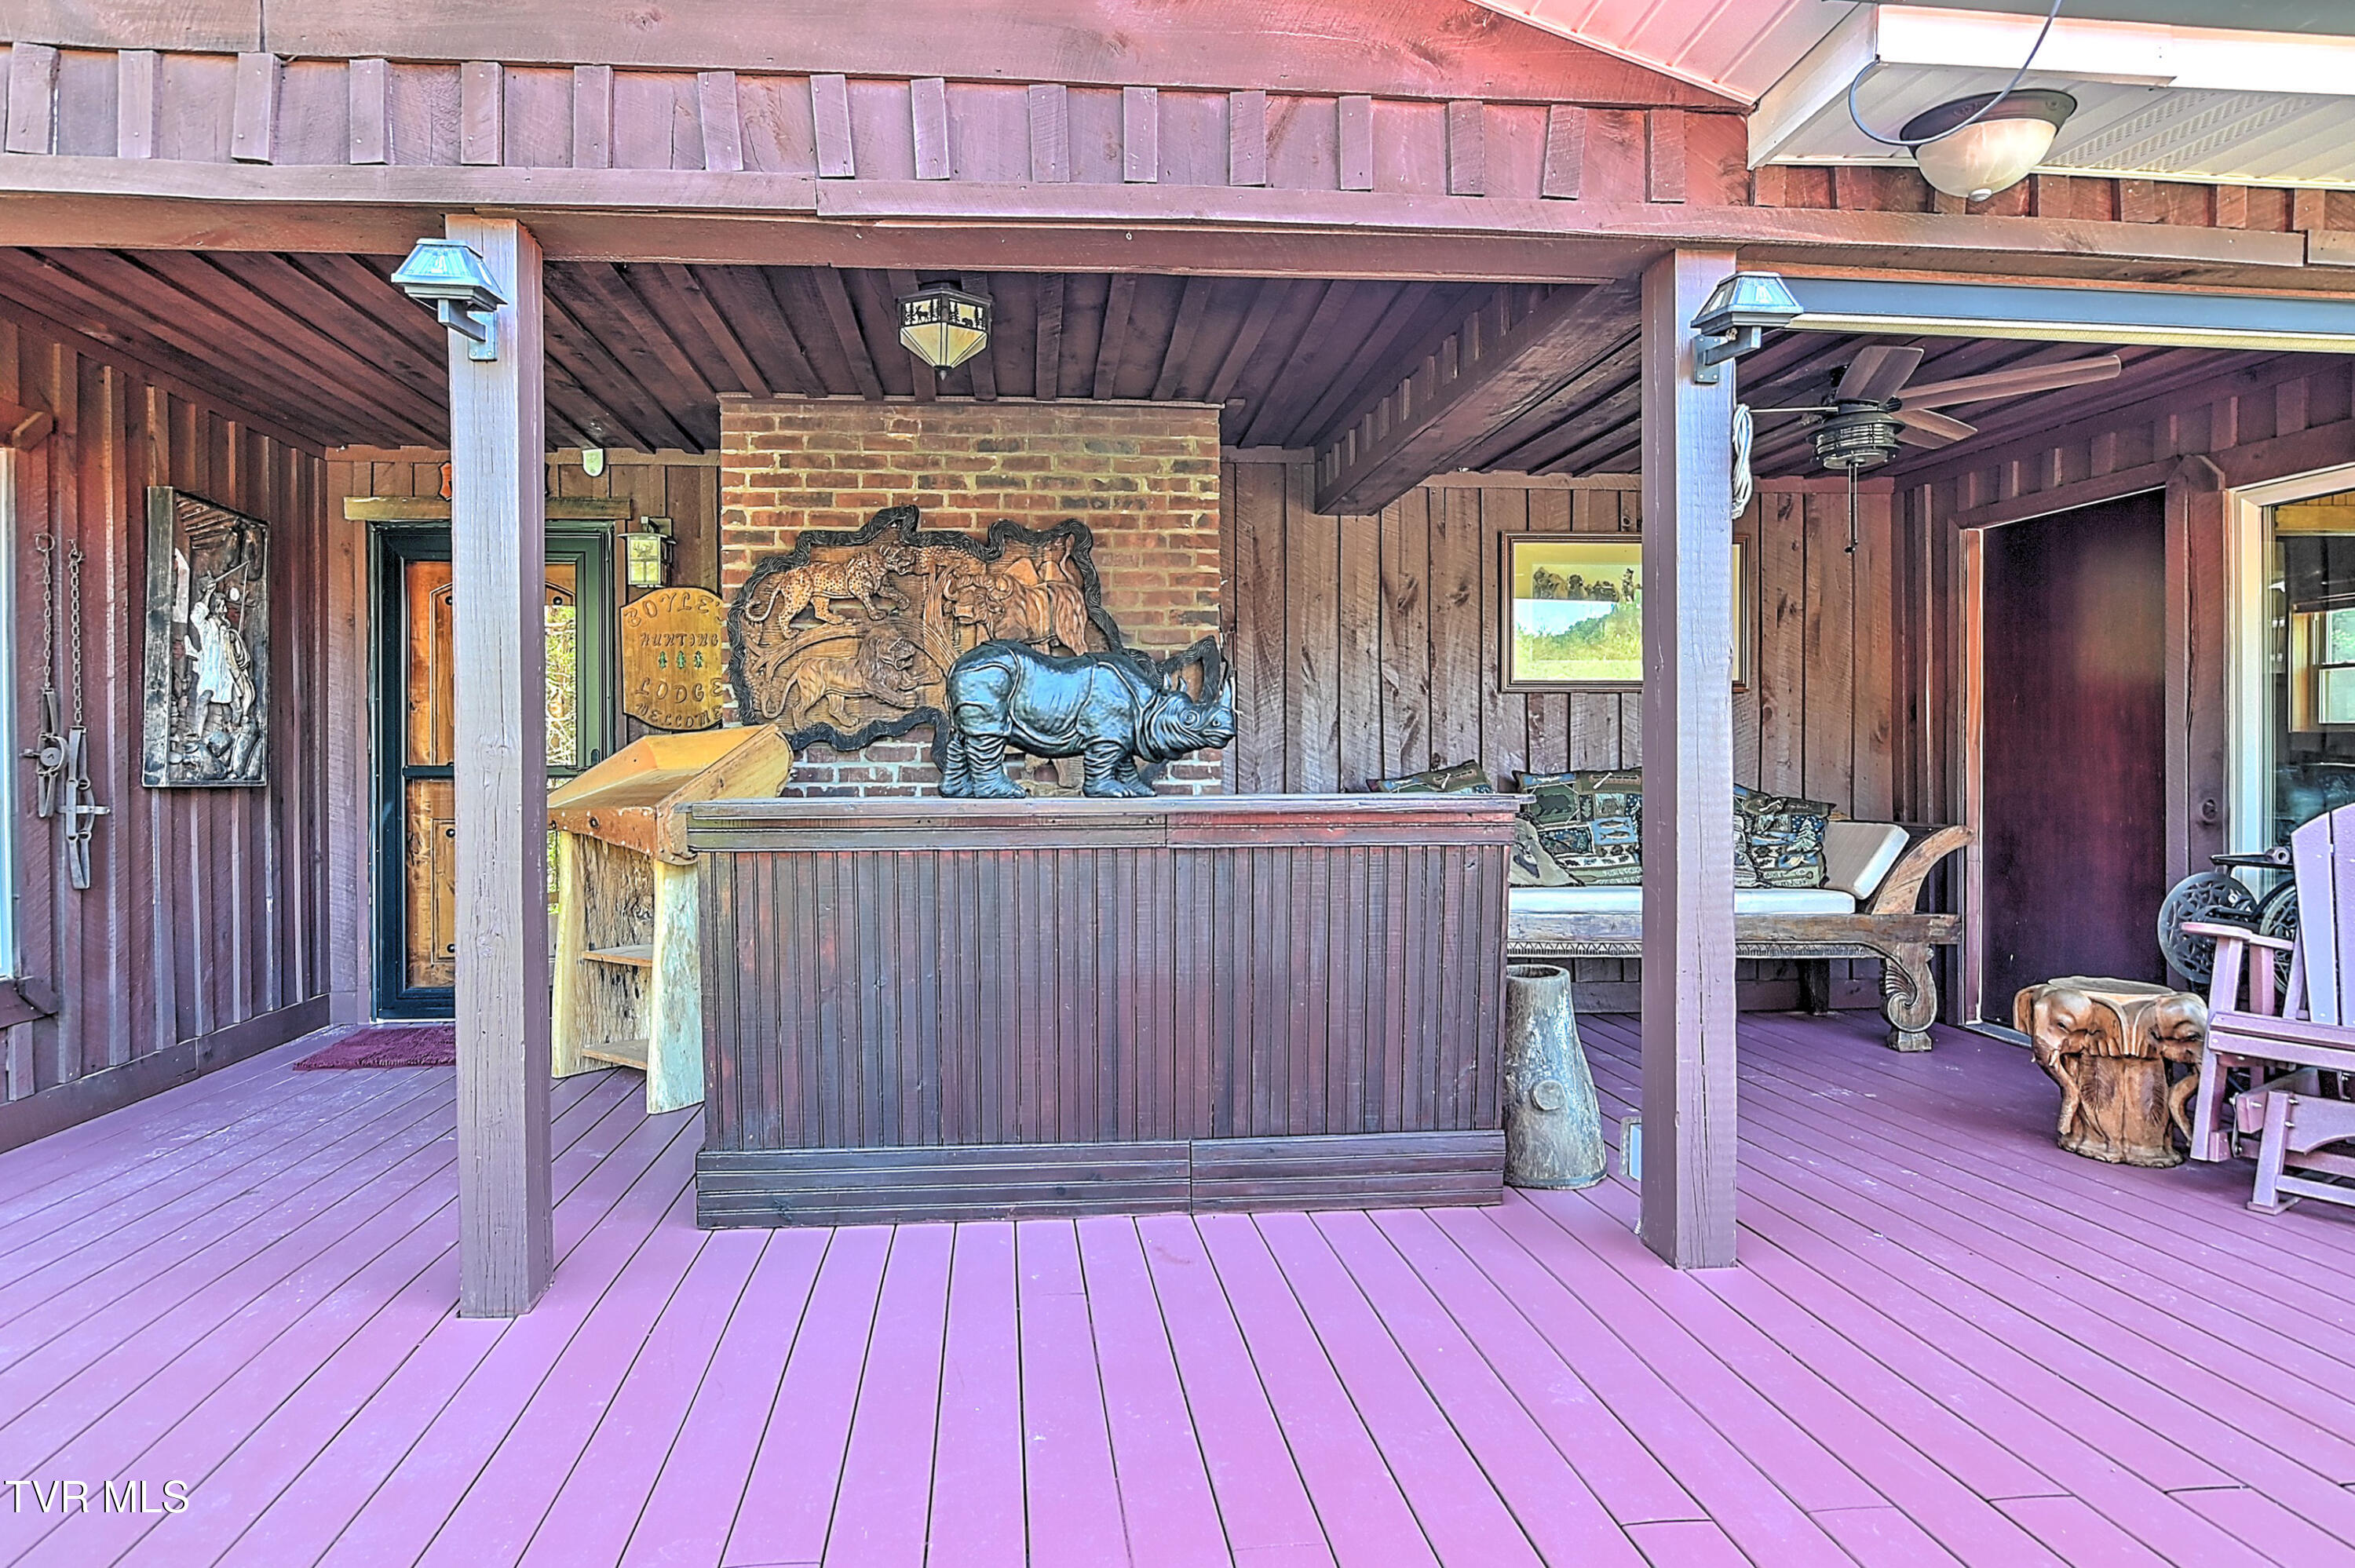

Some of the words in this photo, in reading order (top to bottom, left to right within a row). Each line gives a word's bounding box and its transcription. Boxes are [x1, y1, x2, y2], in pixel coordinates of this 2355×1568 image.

[640, 631, 719, 647] HUNTING
[635, 676, 723, 704] LODGE
[636, 703, 723, 728] WELCOME
